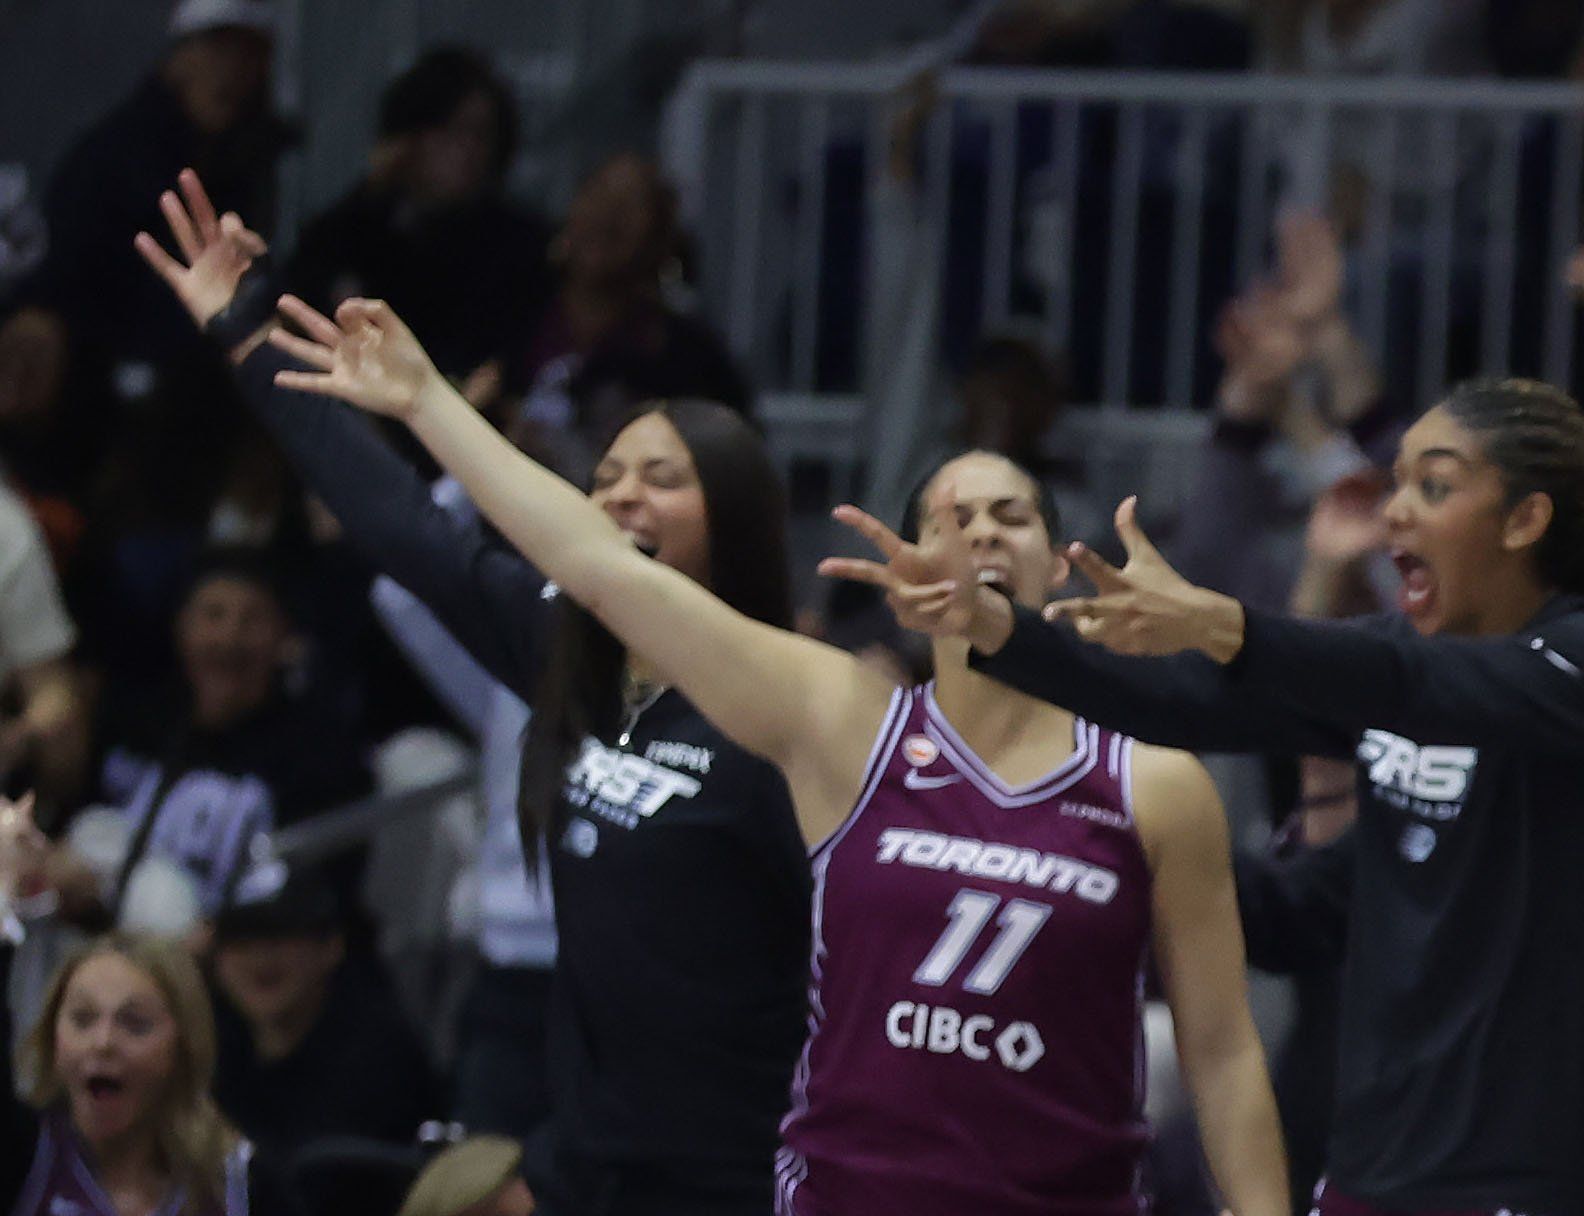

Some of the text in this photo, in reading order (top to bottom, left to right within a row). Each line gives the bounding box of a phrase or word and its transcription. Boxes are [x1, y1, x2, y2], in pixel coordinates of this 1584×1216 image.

[876, 827, 1120, 905] TORONTO
[912, 887, 1054, 996] 11
[886, 1000, 995, 1061] CIBC
